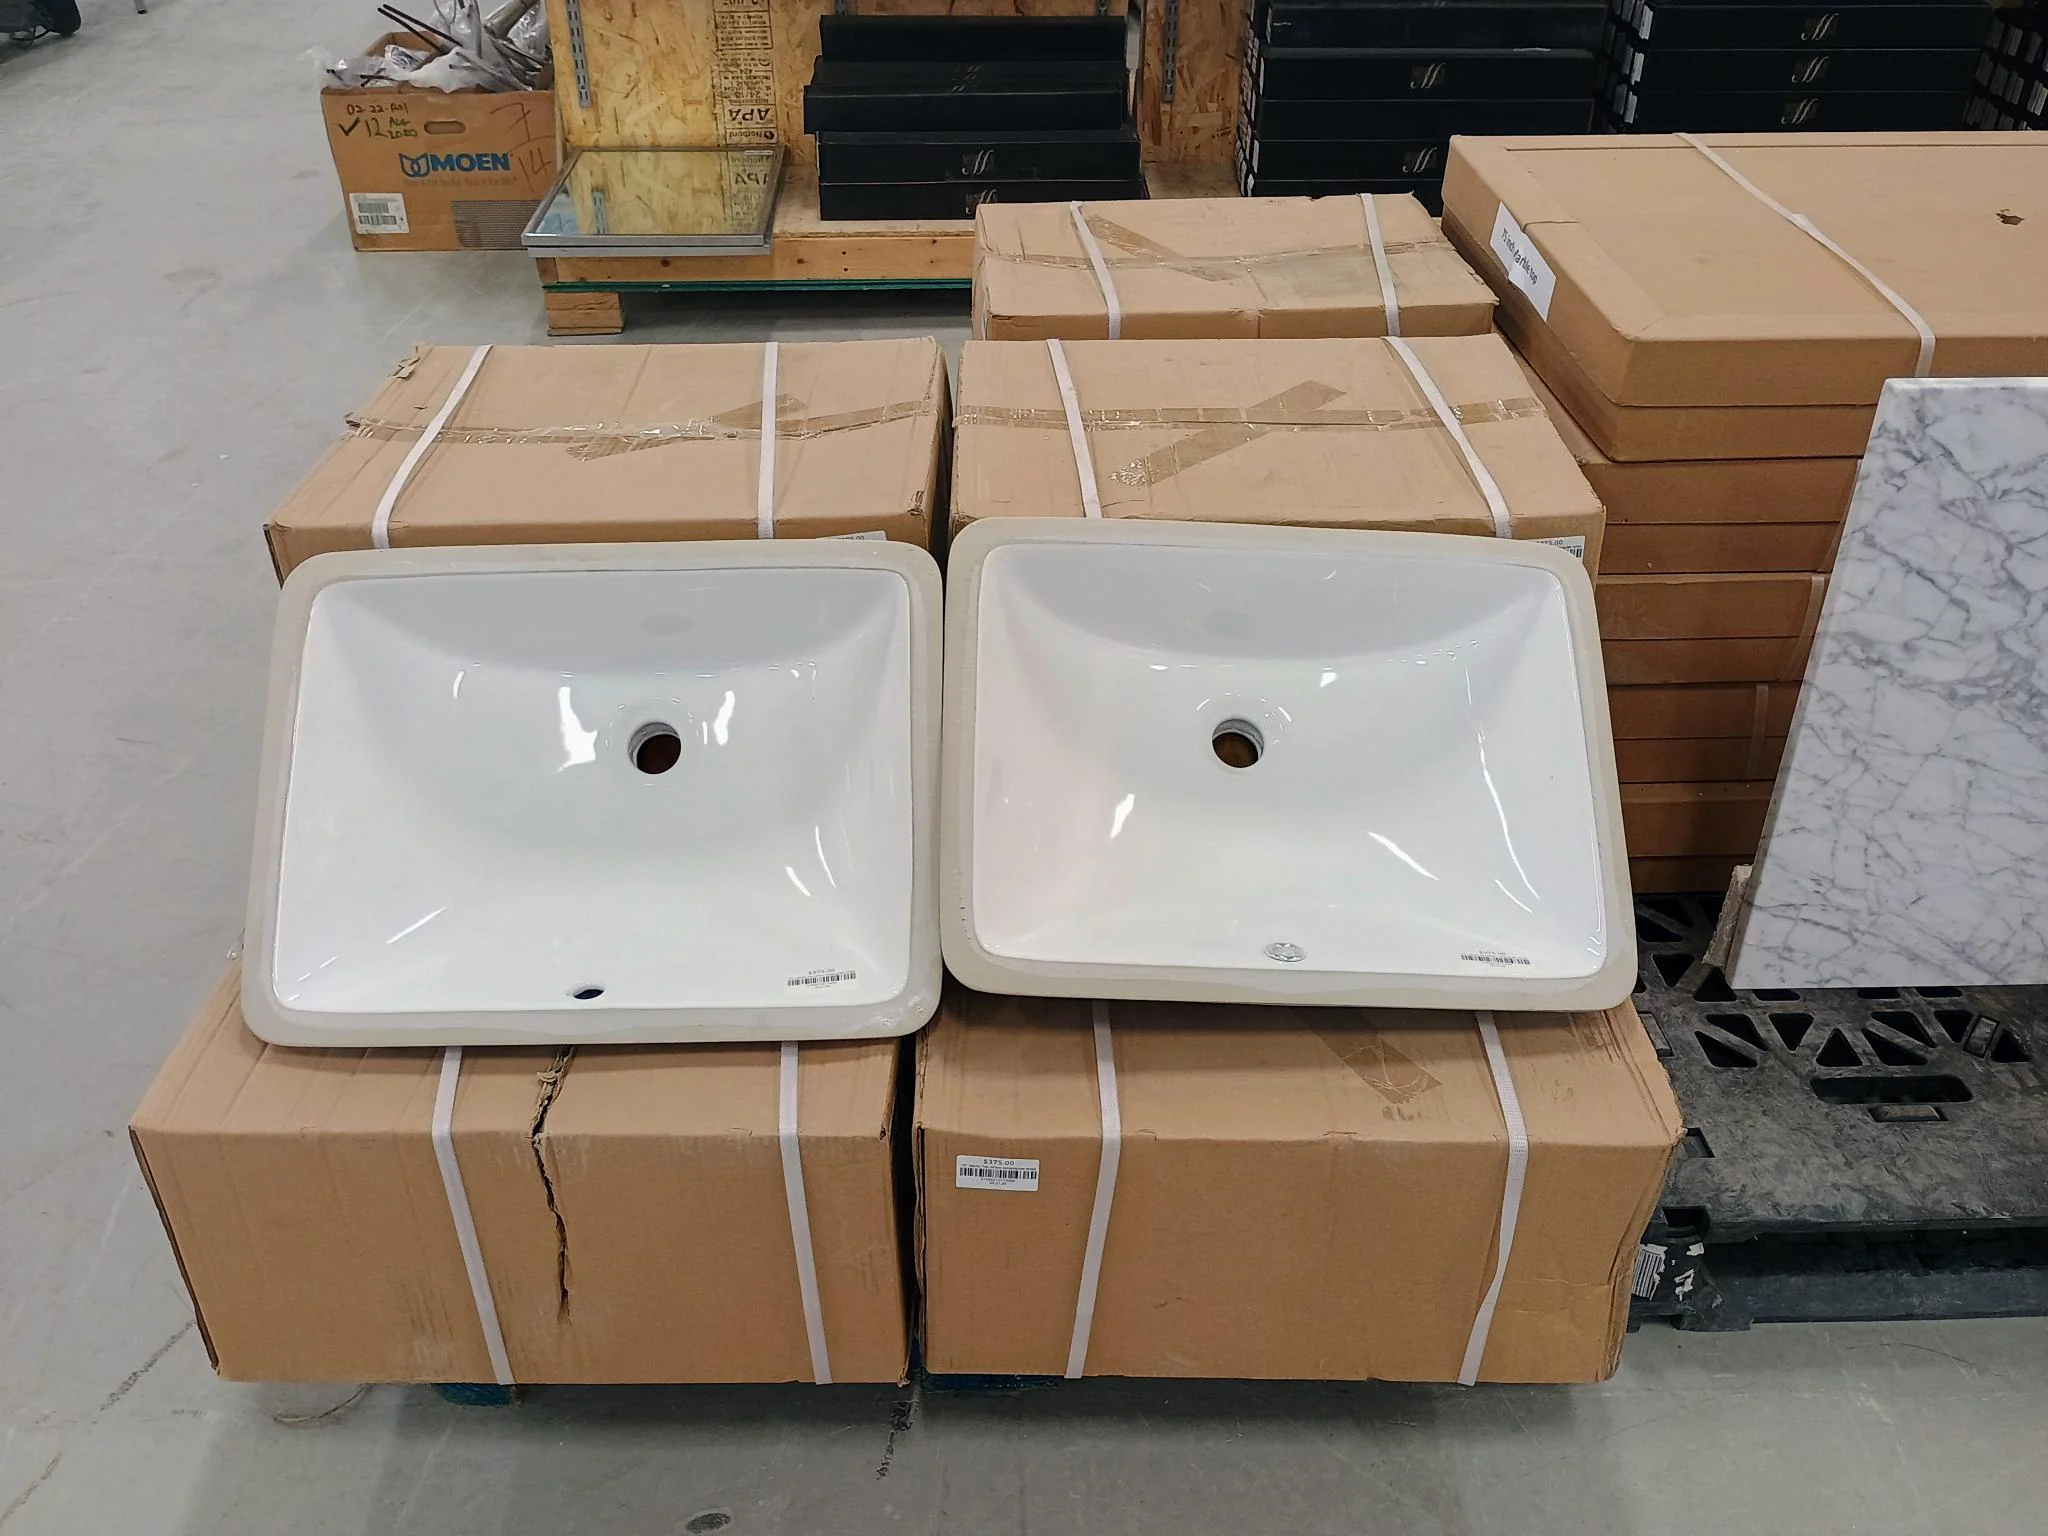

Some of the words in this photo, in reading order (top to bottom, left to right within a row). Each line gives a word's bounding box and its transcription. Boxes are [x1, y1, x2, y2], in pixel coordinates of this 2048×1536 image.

[728, 108, 770, 121] APA
[431, 153, 511, 172] MOEN
[983, 1158, 1015, 1166] $375.00
